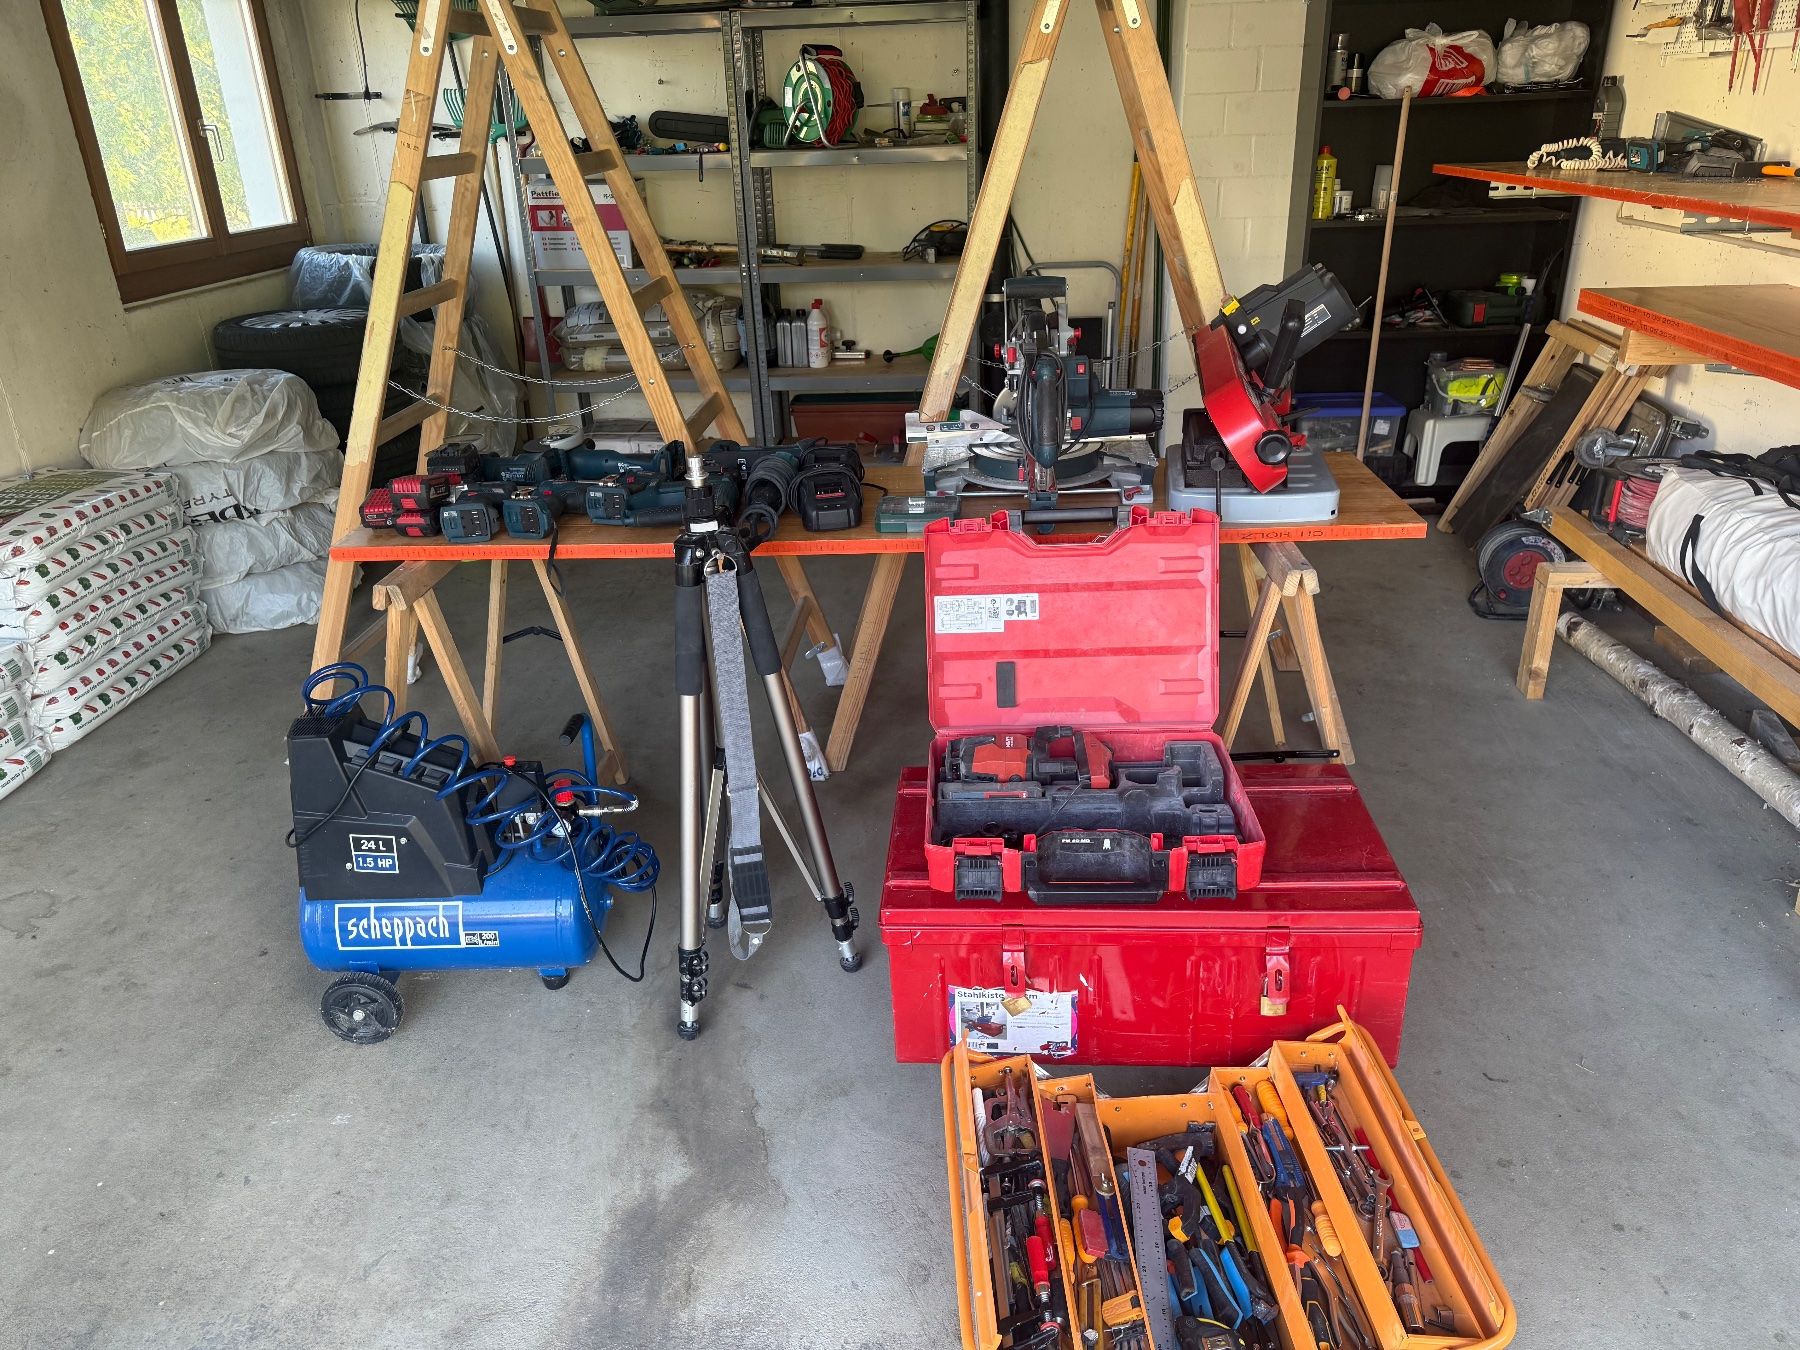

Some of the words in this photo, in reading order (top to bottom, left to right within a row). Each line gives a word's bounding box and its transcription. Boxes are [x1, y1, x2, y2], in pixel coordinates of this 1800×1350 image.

[360, 839, 376, 850] 24
[378, 840, 386, 850] L
[357, 856, 375, 868] 1.5
[378, 858, 392, 868] HP
[347, 905, 449, 947] scheppach
